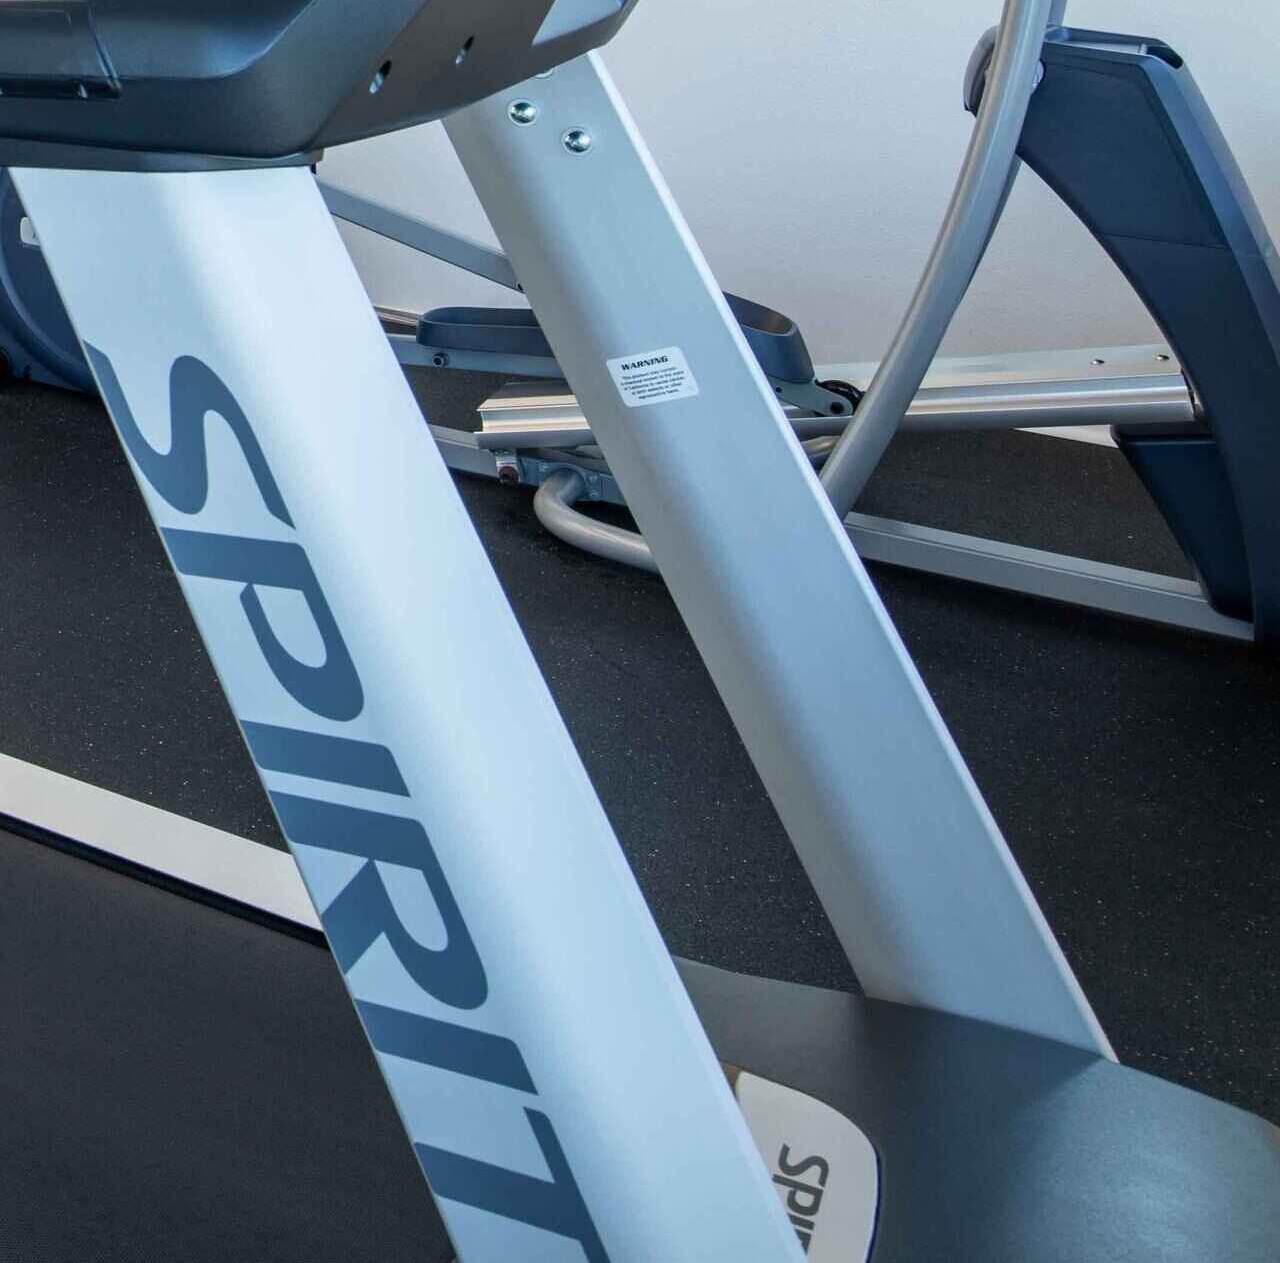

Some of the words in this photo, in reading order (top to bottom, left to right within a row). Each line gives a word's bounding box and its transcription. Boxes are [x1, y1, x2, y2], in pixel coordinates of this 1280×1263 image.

[621, 356, 668, 370] WARNING
[83, 339, 611, 1263] SPIRIT
[772, 1143, 829, 1255] SPI
